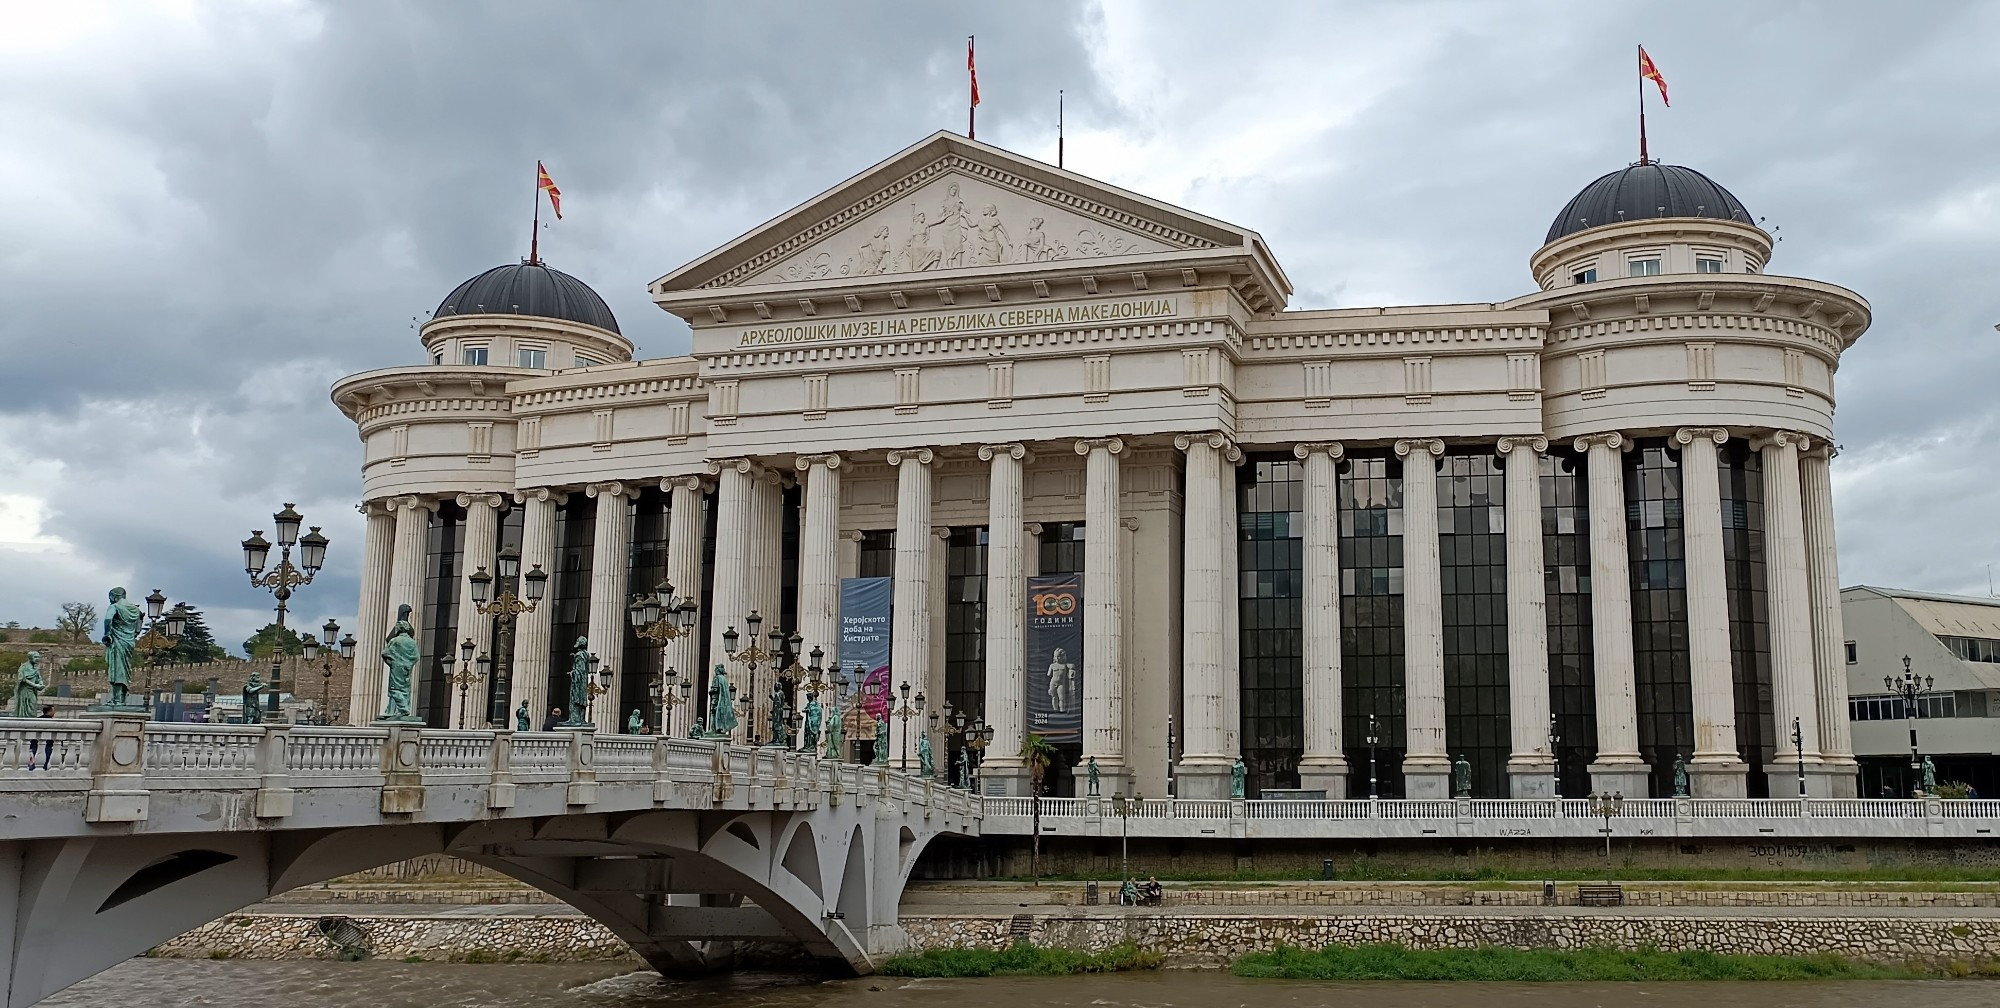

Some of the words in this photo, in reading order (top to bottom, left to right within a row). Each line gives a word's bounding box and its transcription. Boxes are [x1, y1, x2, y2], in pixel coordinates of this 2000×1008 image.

[740, 324, 836, 346] АРХЕОЛОШКИ
[840, 321, 884, 339] МУЗЕЈ
[887, 319, 907, 335] НА
[910, 313, 996, 332] РЕПУБЛИКА
[998, 306, 1065, 327] СЕВЕРНА
[1068, 299, 1172, 322] МАКЕДОНИЈА
[1032, 593, 1076, 615] 100
[843, 615, 886, 625] Херојското
[843, 625, 862, 634] доба
[843, 634, 880, 643] Хистрите
